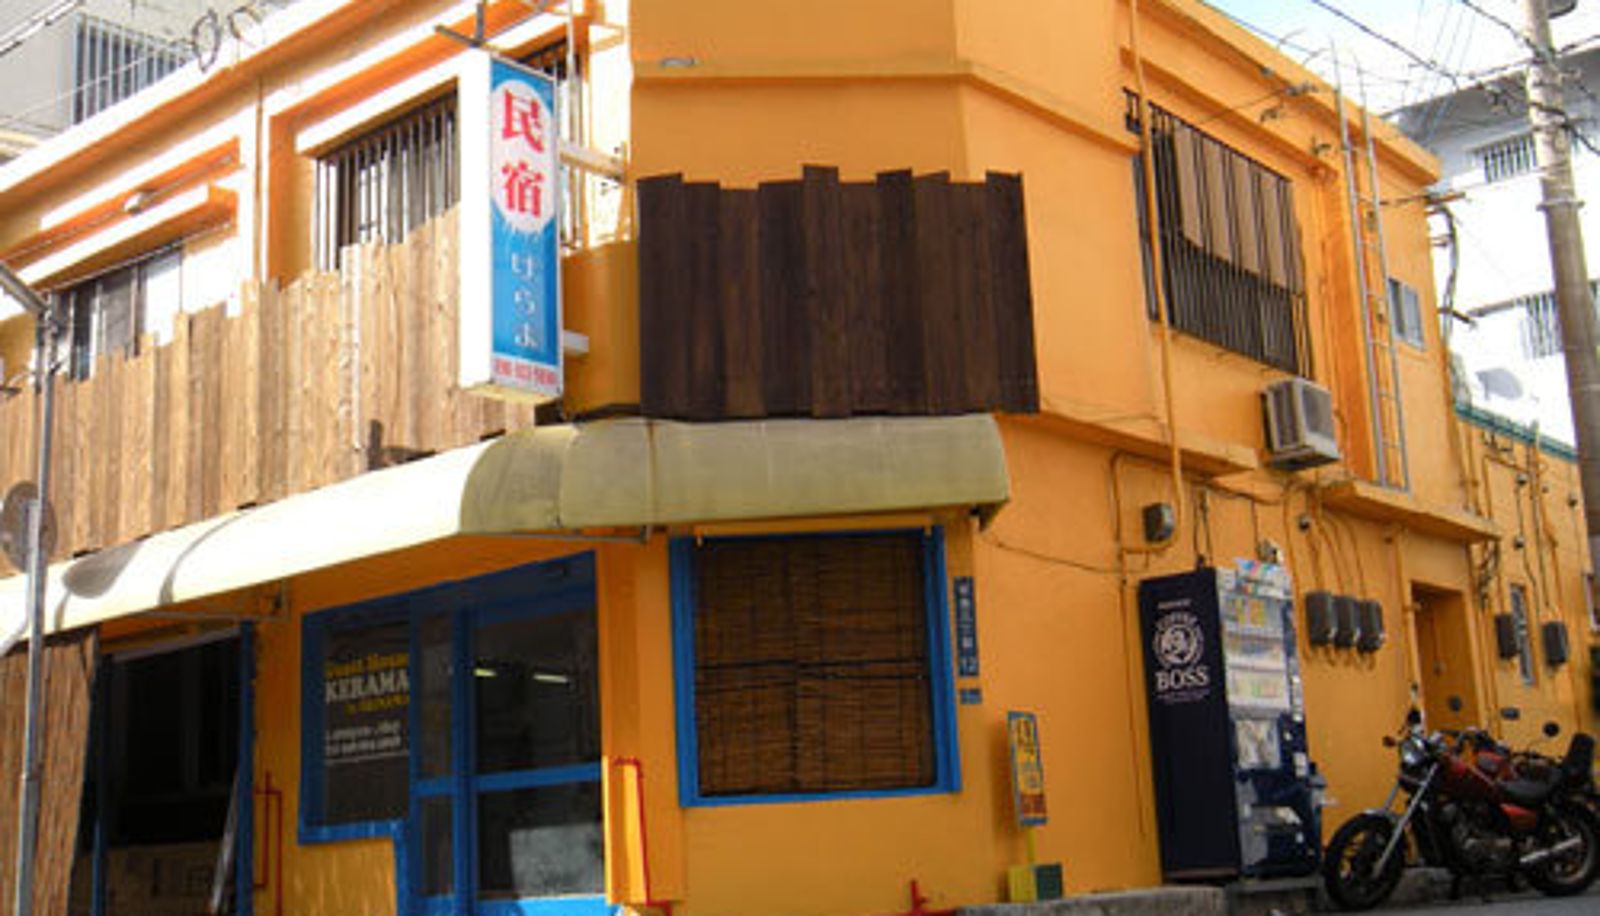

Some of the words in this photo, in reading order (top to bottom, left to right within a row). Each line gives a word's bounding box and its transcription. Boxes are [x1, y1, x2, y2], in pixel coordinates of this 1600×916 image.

[502, 87, 544, 218] 民宿
[325, 669, 410, 704] KERAMA
[1154, 666, 1209, 691] BOSS
